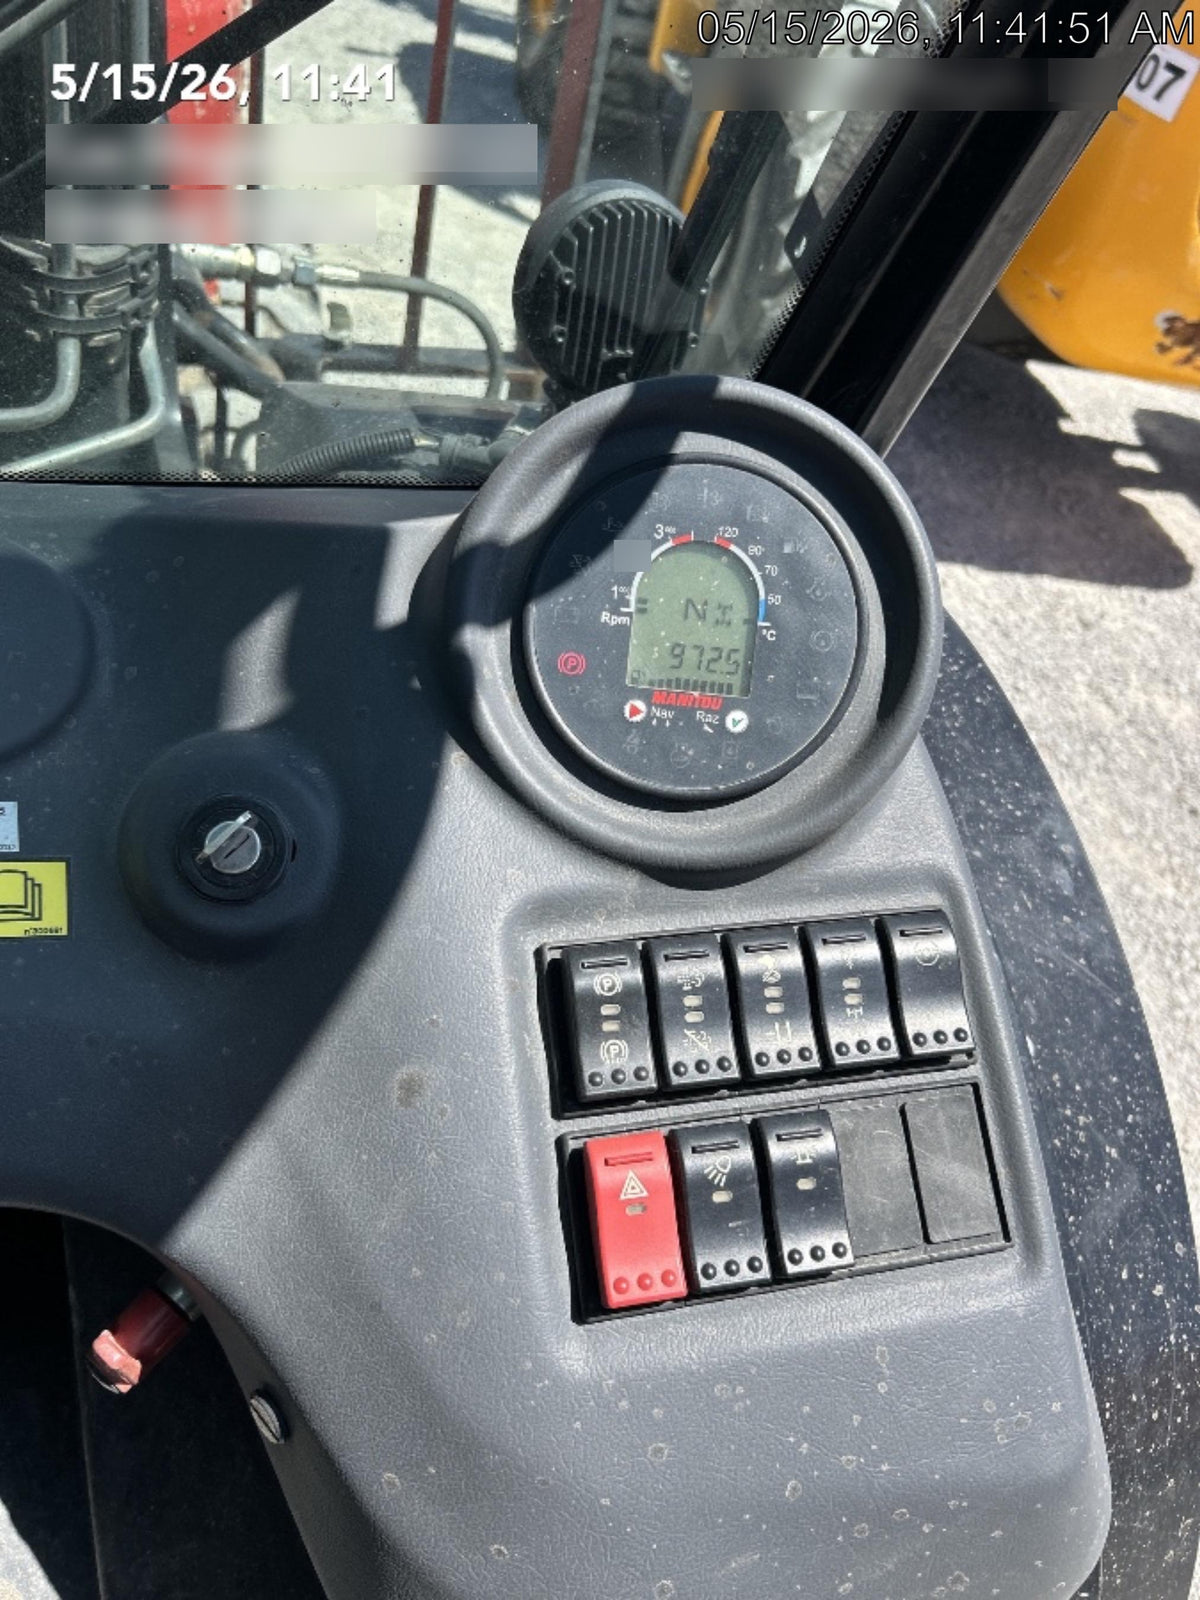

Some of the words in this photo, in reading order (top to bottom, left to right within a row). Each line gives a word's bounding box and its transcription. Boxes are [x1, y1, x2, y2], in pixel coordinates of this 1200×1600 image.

[718, 525, 739, 538] 120
[764, 564, 778, 577] 70
[600, 612, 630, 627] Rpm
[651, 690, 723, 711] MANITOU
